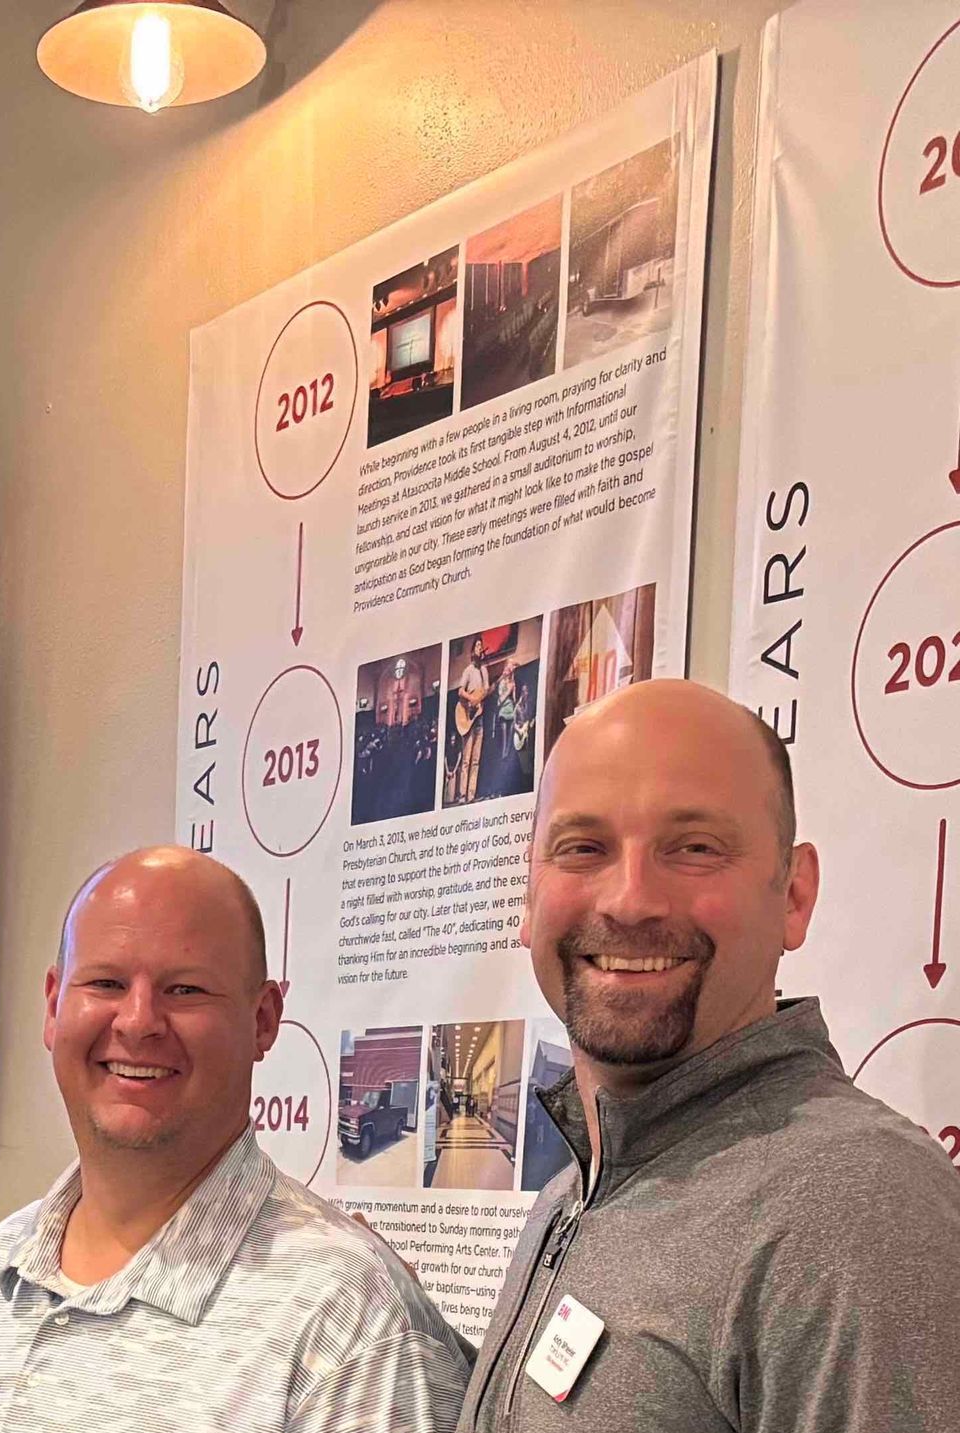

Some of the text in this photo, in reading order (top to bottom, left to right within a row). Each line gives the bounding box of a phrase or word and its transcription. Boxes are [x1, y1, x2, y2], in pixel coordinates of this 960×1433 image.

[561, 377, 596, 401] praying
[598, 370, 612, 385] for
[614, 357, 643, 378] clarity
[644, 346, 666, 365] and
[276, 373, 334, 433] 2012
[544, 409, 564, 426] with
[566, 384, 626, 418] Informational
[598, 409, 618, 428] until
[619, 405, 637, 419] our
[533, 447, 582, 472] auditorium
[545, 476, 561, 490] like
[574, 462, 598, 481] make
[600, 456, 616, 470] the
[617, 442, 653, 467] gospel
[553, 489, 576, 508] filled
[577, 483, 595, 500] with
[597, 476, 620, 492] faith
[622, 467, 643, 486] and
[563, 509, 583, 527] what
[585, 498, 615, 518] would
[617, 488, 655, 509] become
[262, 738, 319, 787] 2013
[454, 817, 481, 833] official
[481, 811, 508, 828] launch
[459, 840, 480, 855] glory
[472, 854, 520, 870] Providence
[475, 876, 491, 890] and
[492, 875, 508, 888] the
[452, 901, 468, 914] that
[458, 917, 503, 933] dedicating
[447, 940, 488, 956] beginning
[489, 936, 508, 950] and
[254, 1095, 309, 1131] 2014
[374, 1202, 419, 1213] momentum
[421, 1203, 436, 1214] and
[445, 1204, 469, 1216] desire
[471, 1205, 479, 1216] to
[480, 1206, 497, 1217] root
[379, 1220, 427, 1233] transitioned
[428, 1223, 438, 1233] to
[440, 1222, 468, 1238] Sunday
[469, 1226, 501, 1240] morning
[410, 1240, 454, 1256] Performing
[455, 1243, 472, 1255] Arts
[421, 1261, 503, 1278] growth for our church
[441, 1301, 480, 1318] lives being
